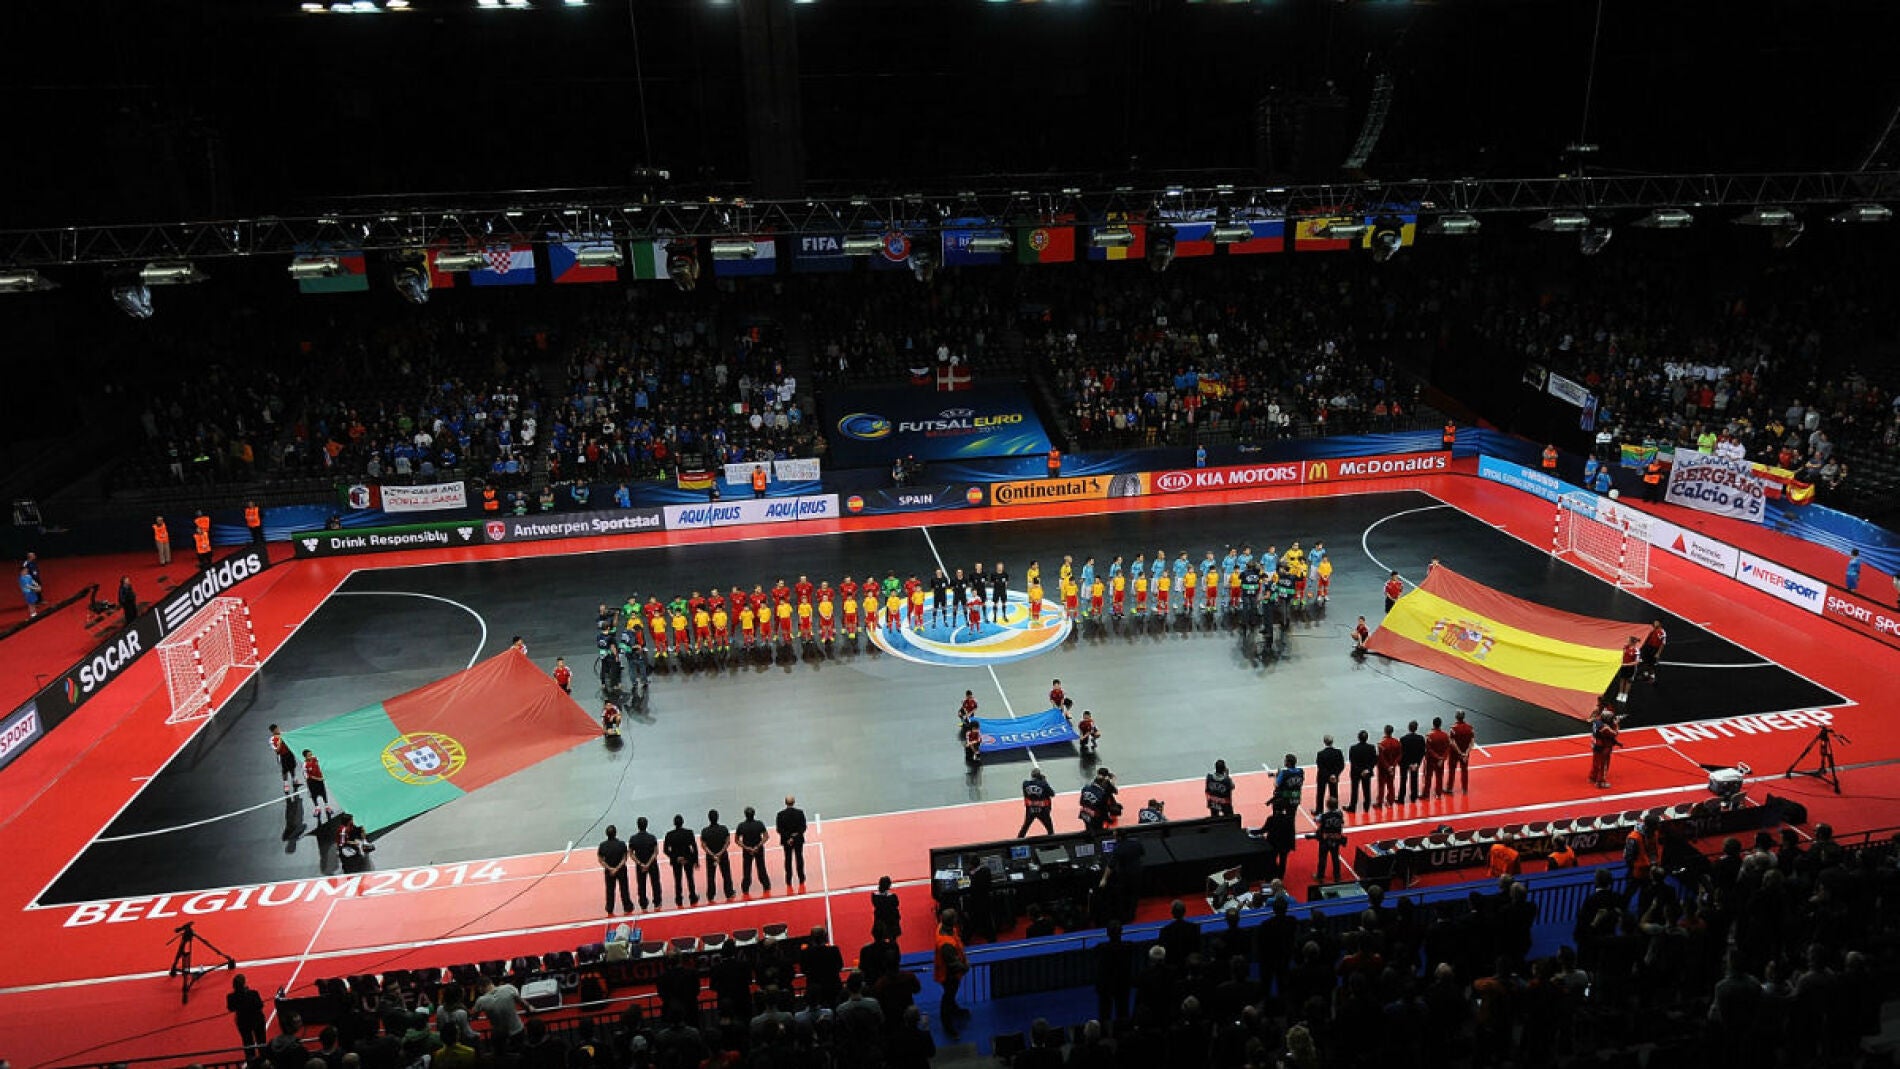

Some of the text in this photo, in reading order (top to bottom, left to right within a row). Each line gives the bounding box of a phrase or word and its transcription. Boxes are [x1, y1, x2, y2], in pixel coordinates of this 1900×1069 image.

[802, 237, 838, 251] FIFA
[1339, 456, 1446, 475] McDonald's
[1196, 472, 1224, 486] KIA
[1228, 467, 1297, 484] MOTORS
[898, 494, 934, 506] SPAIN
[995, 480, 1087, 504] Continental
[1671, 482, 1728, 505] Calcio
[1749, 498, 1761, 514] 5
[678, 504, 742, 525] AQUARIUS
[765, 498, 827, 518] AQUARIUS
[514, 514, 660, 537] Antwerpen Sportstad
[331, 530, 449, 549] Drink Responsibly
[190, 552, 262, 606] adidas
[1752, 566, 1819, 601] INTERSPORT
[1827, 597, 1872, 622] SPORT
[80, 629, 142, 693] SOCAR
[1000, 726, 1067, 742] RESPECT
[1656, 709, 1834, 744] ANTWERP
[1431, 848, 1485, 867] UEFA
